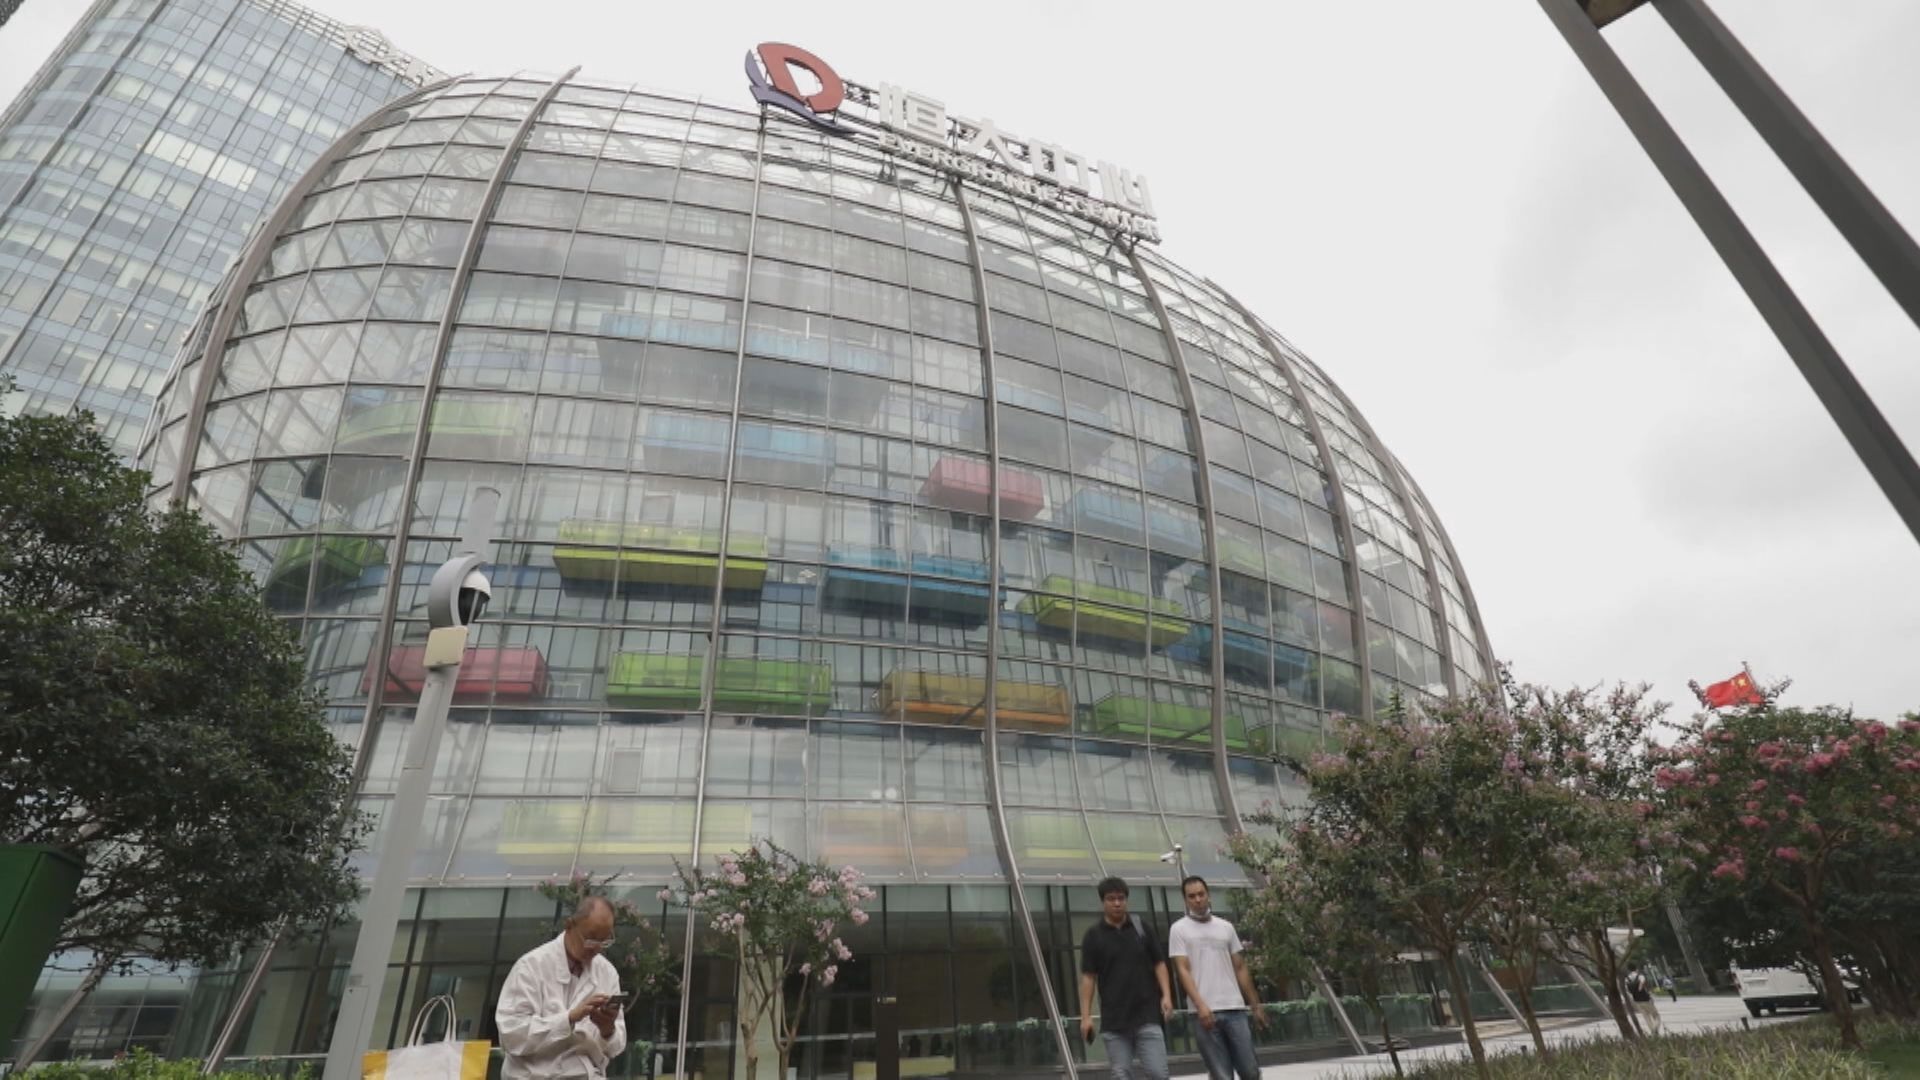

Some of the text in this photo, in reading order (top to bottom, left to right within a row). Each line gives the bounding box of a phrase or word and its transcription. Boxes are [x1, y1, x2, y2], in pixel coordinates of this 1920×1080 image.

[879, 82, 1156, 219] 恒大中心
[879, 132, 1161, 244] EVERGRANDE CENTER
